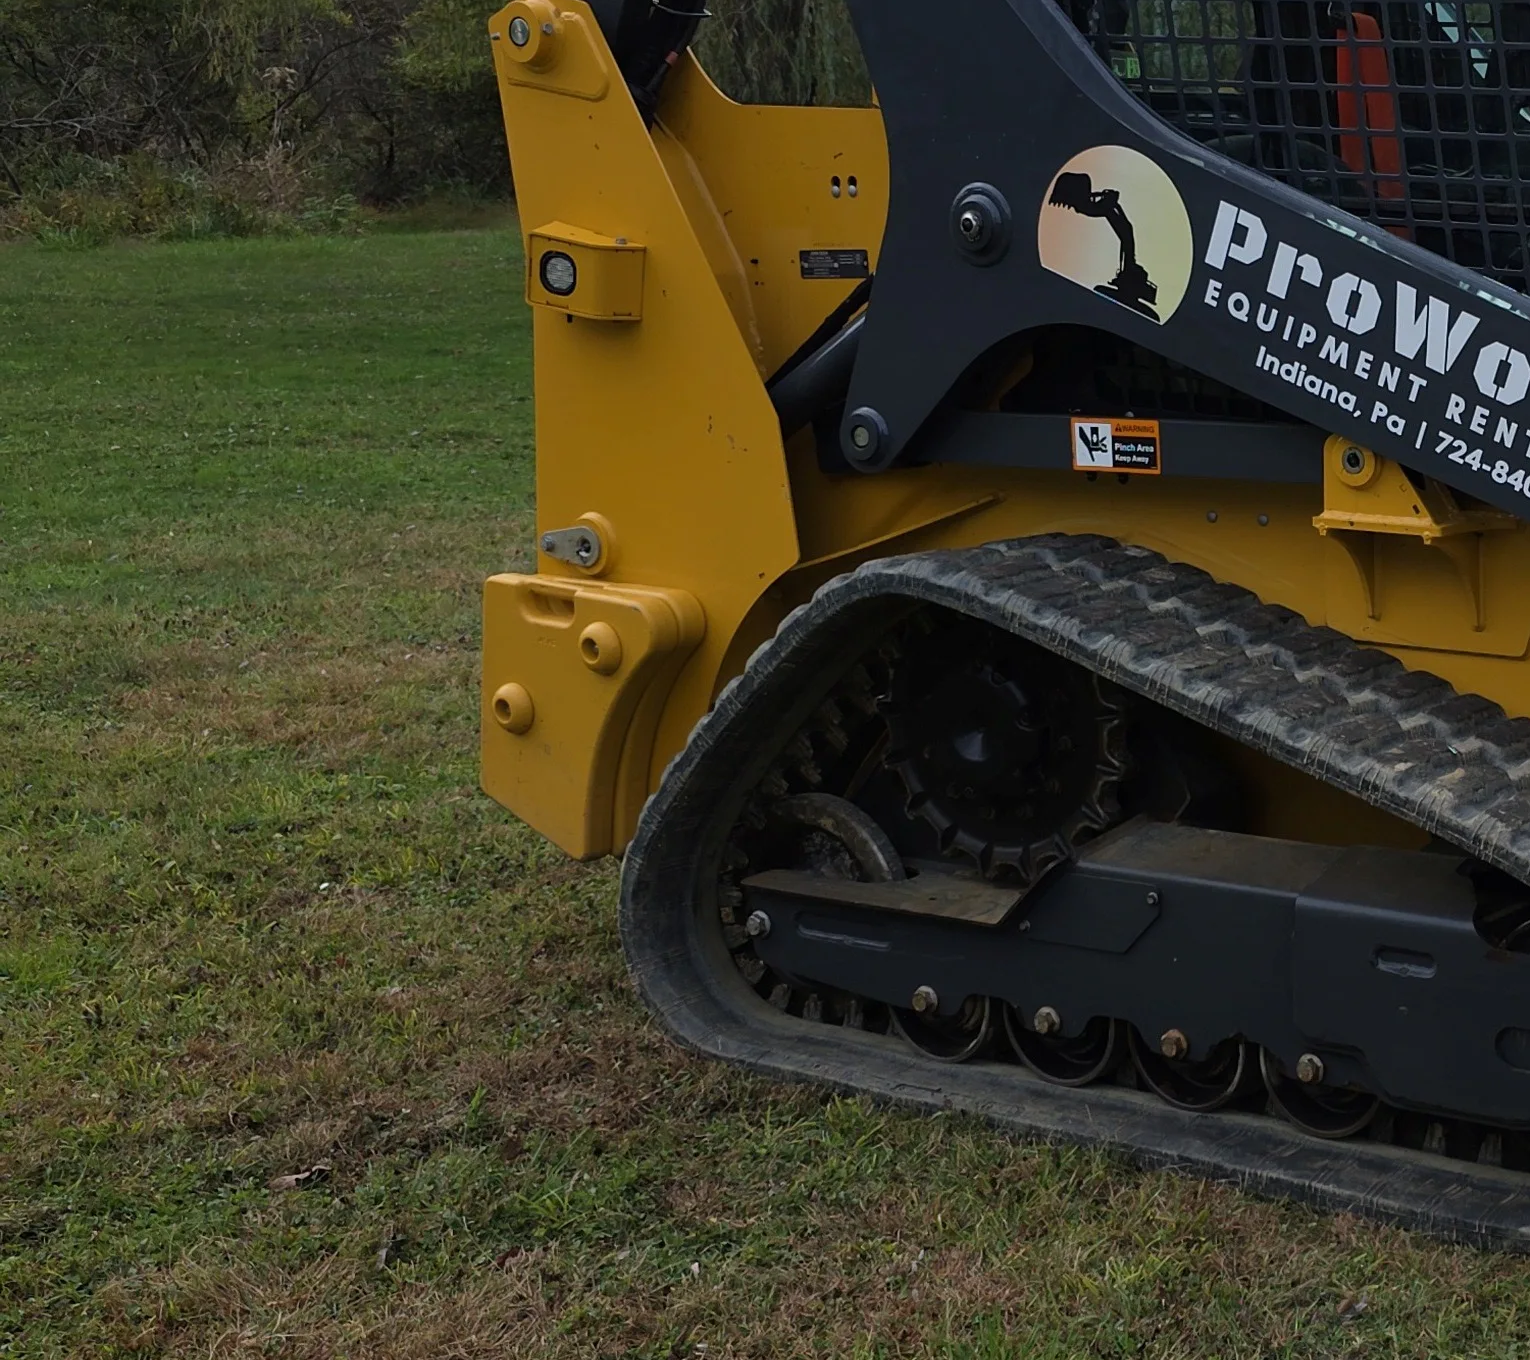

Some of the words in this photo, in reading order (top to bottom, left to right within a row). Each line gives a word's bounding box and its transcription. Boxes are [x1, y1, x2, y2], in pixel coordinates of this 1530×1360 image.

[1203, 278, 1428, 403] EQUIPMENT
[1255, 345, 1362, 418] Indiana,
[1370, 401, 1406, 436] Pa
[1122, 424, 1155, 433] WARNING
[1114, 442, 1136, 452] Pinch
[1136, 443, 1155, 453] Area
[1115, 454, 1131, 463] Keep
[1132, 455, 1149, 465] Away
